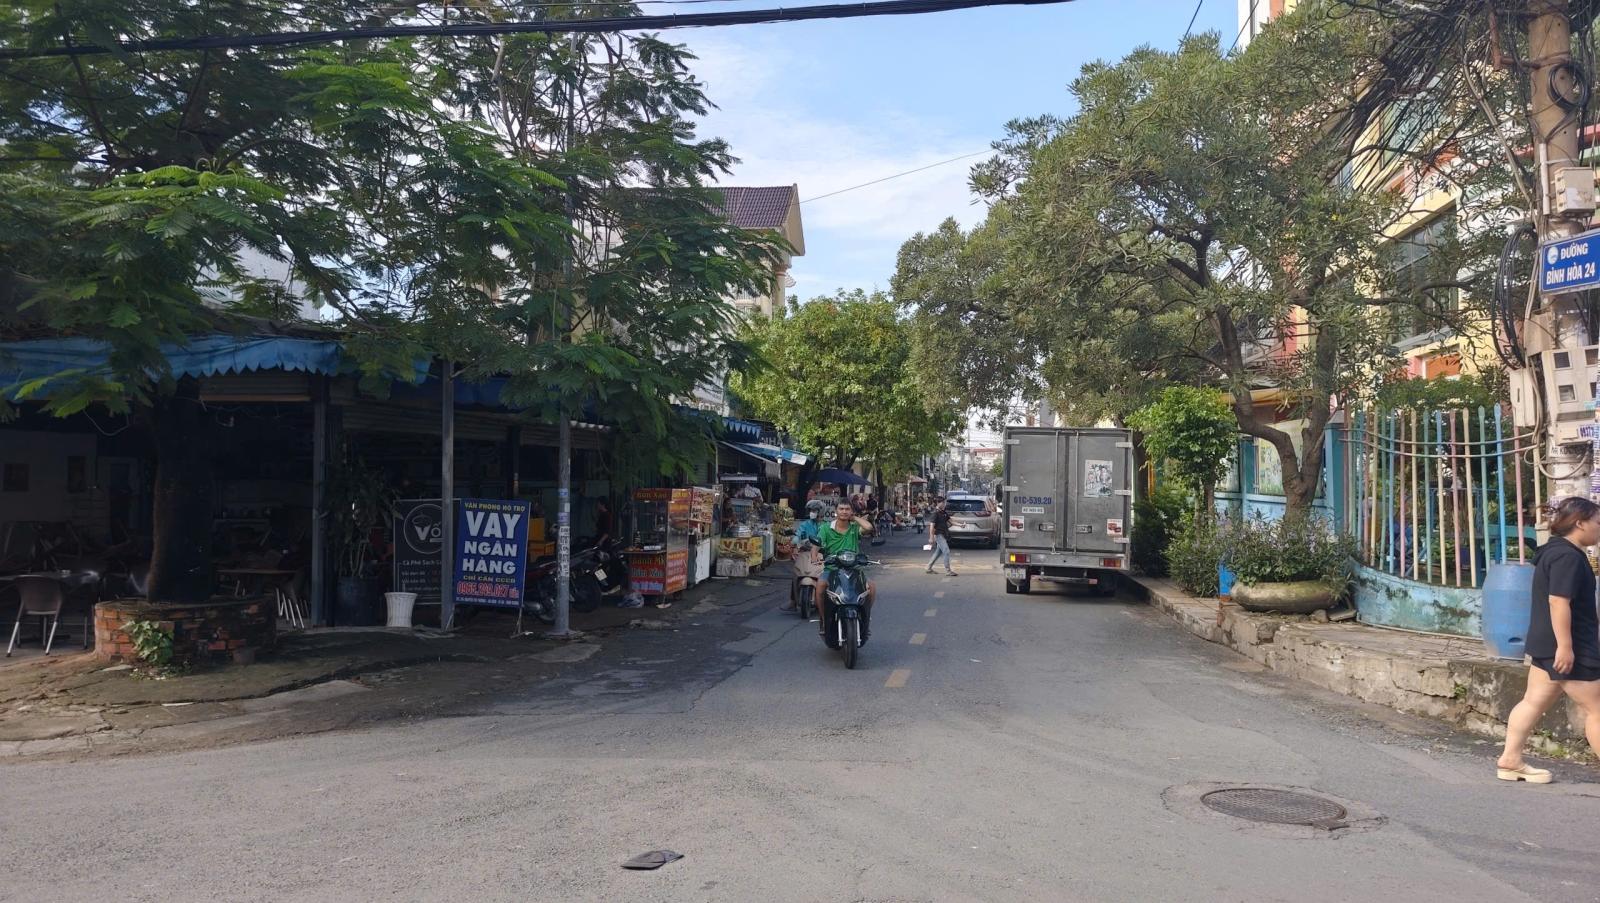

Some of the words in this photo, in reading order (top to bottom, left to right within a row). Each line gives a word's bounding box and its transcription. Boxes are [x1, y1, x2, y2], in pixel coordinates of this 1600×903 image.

[1560, 242, 1589, 260] ĐƯỜNG
[1546, 266, 1565, 285] BÌNH
[1566, 262, 1583, 282] HÒA
[1584, 261, 1596, 278] 24
[465, 510, 521, 539] VAY
[464, 540, 518, 557] NGÂN
[462, 557, 516, 575] HÀNG
